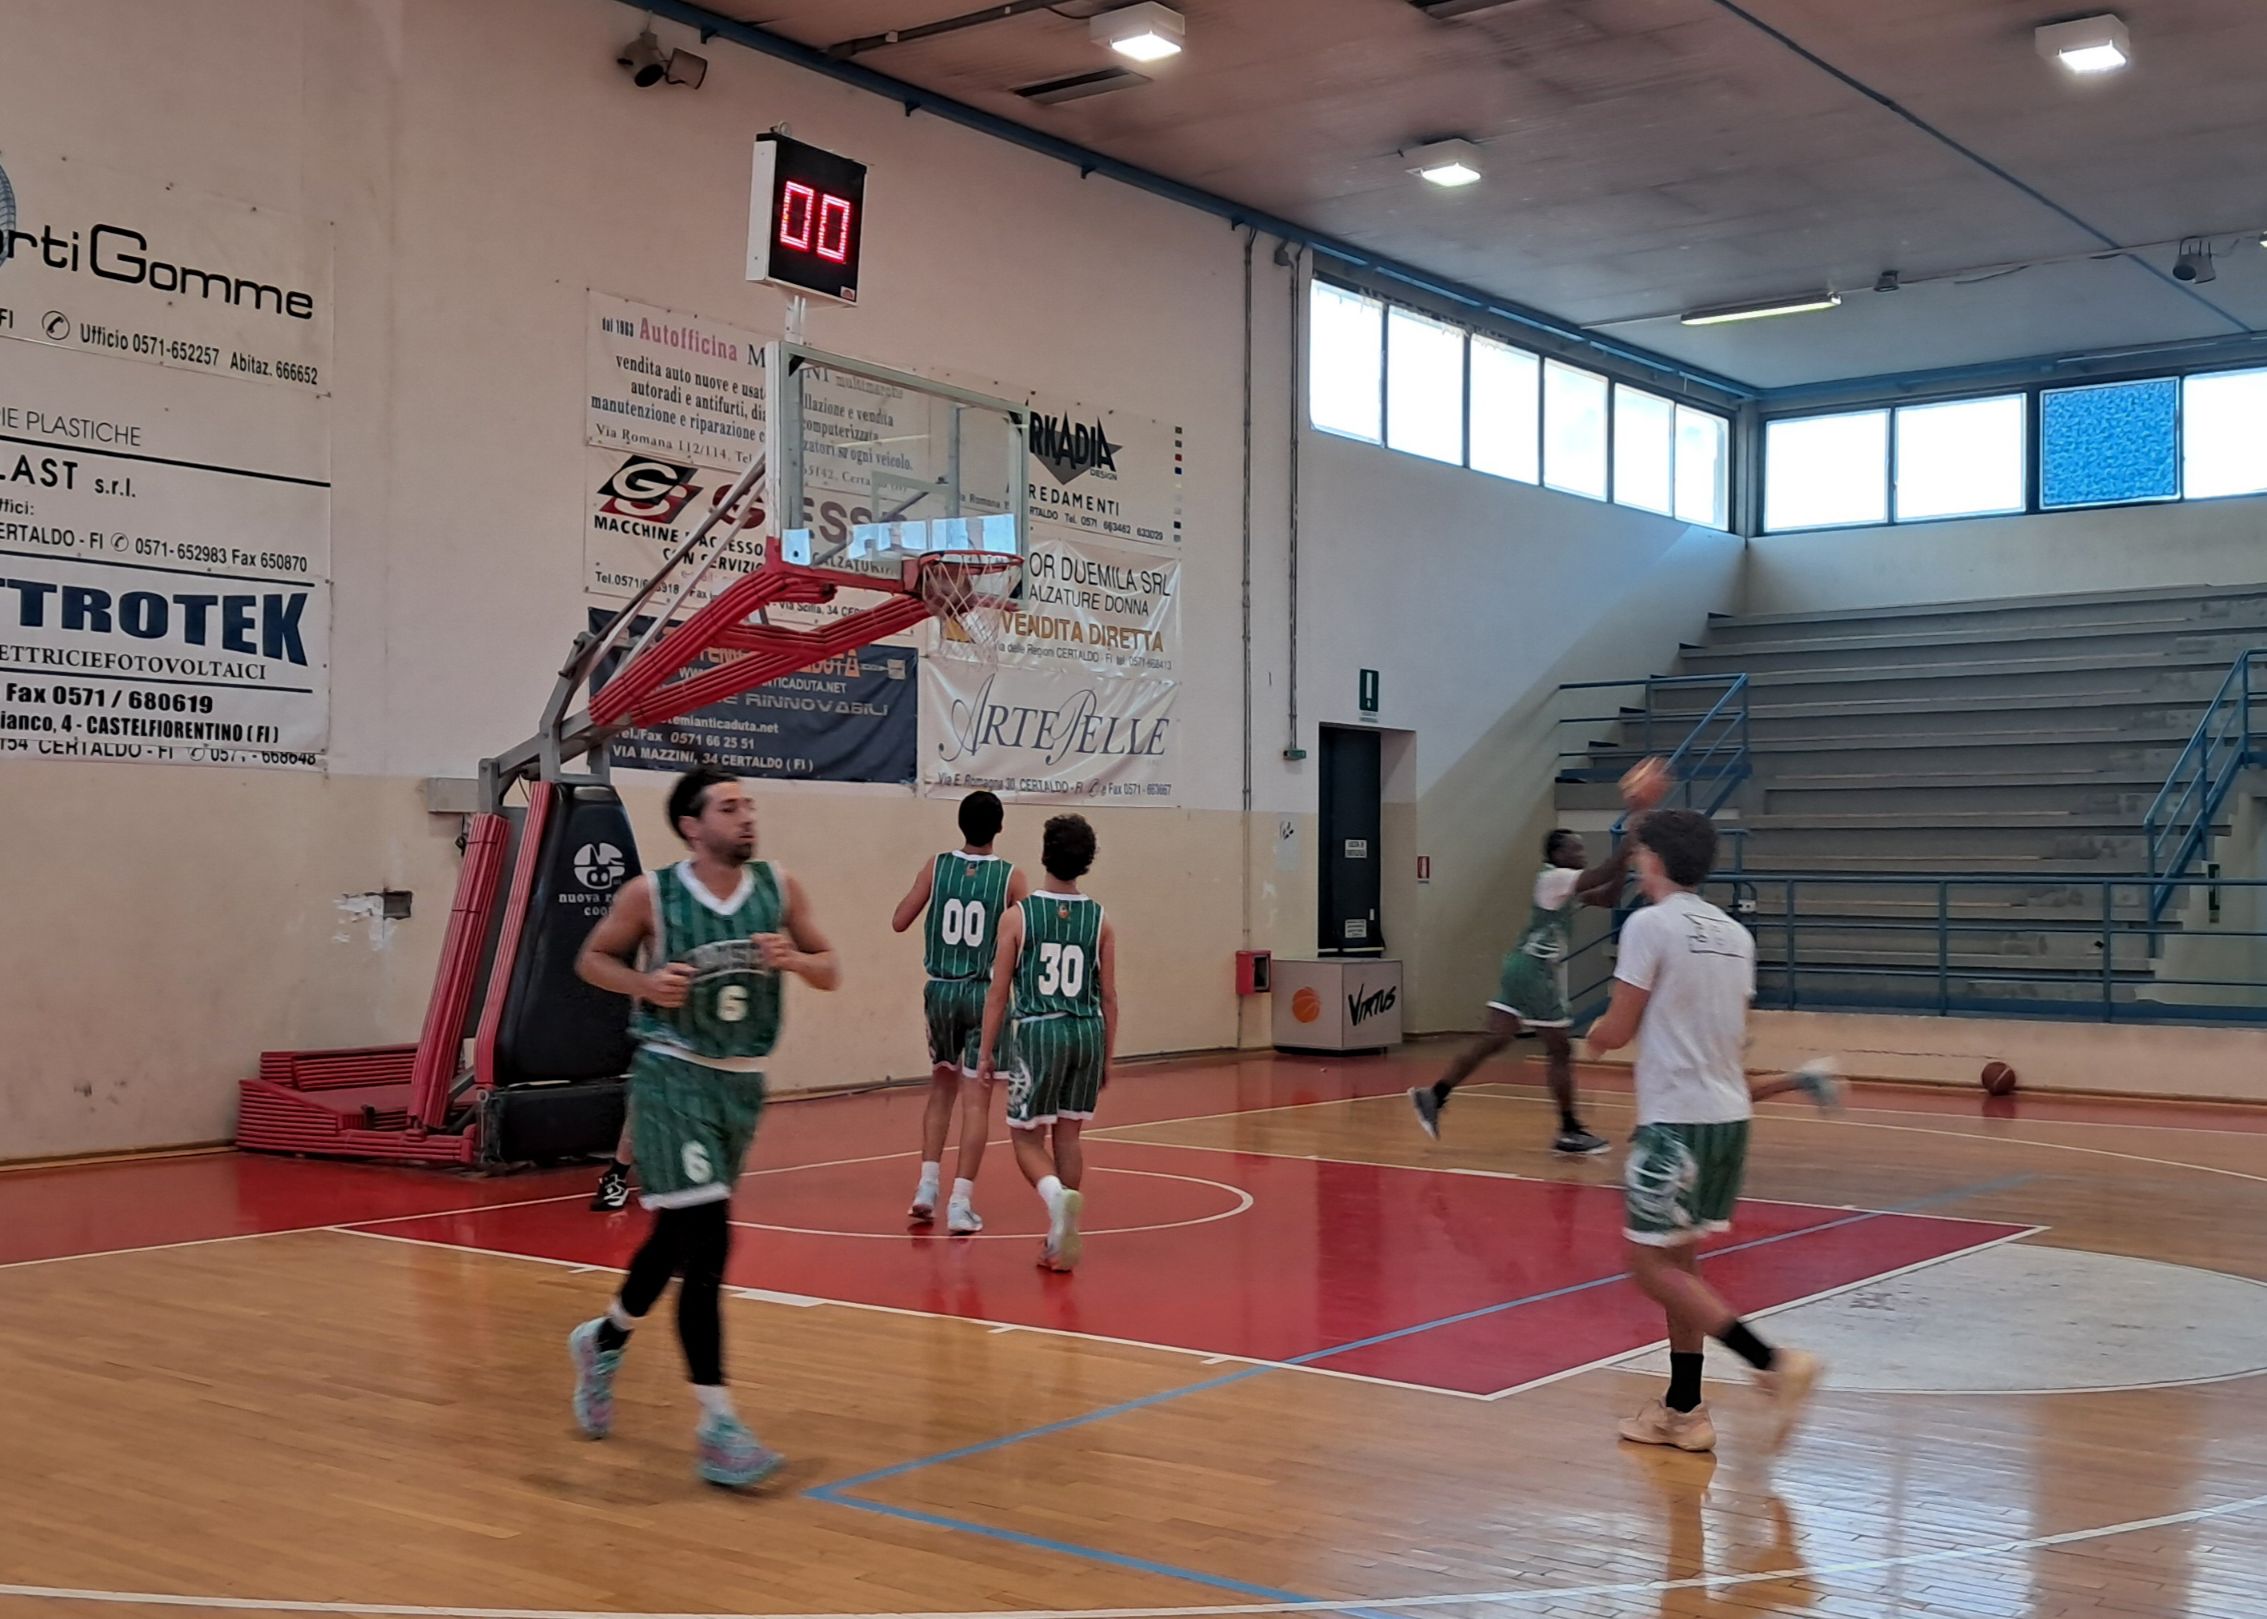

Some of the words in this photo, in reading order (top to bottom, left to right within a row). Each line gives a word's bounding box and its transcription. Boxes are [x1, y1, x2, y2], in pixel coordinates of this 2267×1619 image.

[779, 180, 851, 263] 00
[0, 225, 79, 272] rti
[80, 322, 129, 351] Ufficio
[132, 334, 220, 367] 0571-652257
[230, 351, 273, 377] Abitaz.
[275, 360, 319, 386] 666652
[639, 317, 738, 362] Autofficina
[616, 352, 662, 378] vendita
[665, 366, 692, 384] auto
[694, 373, 729, 392] nuove
[732, 381, 738, 394] e
[742, 383, 766, 401] usat
[591, 395, 676, 426] manutenzione
[680, 413, 686, 427] e
[690, 413, 755, 442] riparazione
[630, 381, 682, 405] autoradi
[685, 391, 692, 405] e
[695, 395, 748, 420] antifurti,
[848, 408, 854, 420] e
[856, 408, 894, 427] vendita
[0, 407, 19, 430] IE
[26, 410, 142, 447] PLASTICHE
[595, 423, 617, 438] Via
[622, 428, 673, 450] Romana
[1029, 411, 1117, 472] RKADIA
[850, 447, 874, 466] ogni
[94, 478, 136, 498] s.r.l.
[1029, 484, 1120, 517] REDAMENTI
[594, 514, 680, 544] MACCHINE
[1029, 506, 1059, 520] RTALDO
[89, 531, 104, 550] FI
[232, 549, 257, 568] Fax
[260, 552, 308, 573] 650870
[1061, 557, 1138, 592] DUEMILA
[1140, 571, 1172, 597] SRL
[827, 604, 838, 615] 34
[1029, 584, 1101, 610] ALZATURE
[1104, 595, 1149, 616] DONNA
[0, 577, 309, 668] TROTEK
[1001, 612, 1084, 644] VENDITA
[1089, 623, 1164, 653] DIRETTA
[1056, 647, 1099, 663] CERTALDO
[6, 682, 46, 704] Fax
[52, 685, 106, 708] 0571
[128, 690, 214, 714] 680619
[0, 711, 57, 734] ianco,
[61, 714, 72, 733] 4
[86, 715, 243, 743] CASTELFIORENTINO
[615, 727, 663, 742] el./Fax
[670, 731, 702, 746] 0571
[706, 734, 721, 747] 66
[723, 736, 738, 748] 25
[741, 738, 755, 750] 51
[613, 745, 637, 759] VIA
[640, 747, 698, 765] MAZZINI,
[702, 752, 718, 765] 34
[721, 754, 783, 770] CERTALDO
[1019, 778, 1069, 794] CERTALDO
[558, 893, 600, 903] nuova
[583, 906, 609, 917] coo
[942, 897, 986, 948] 00
[1038, 942, 1085, 999] 30
[716, 984, 748, 1023] 6
[680, 1139, 713, 1183] 6
